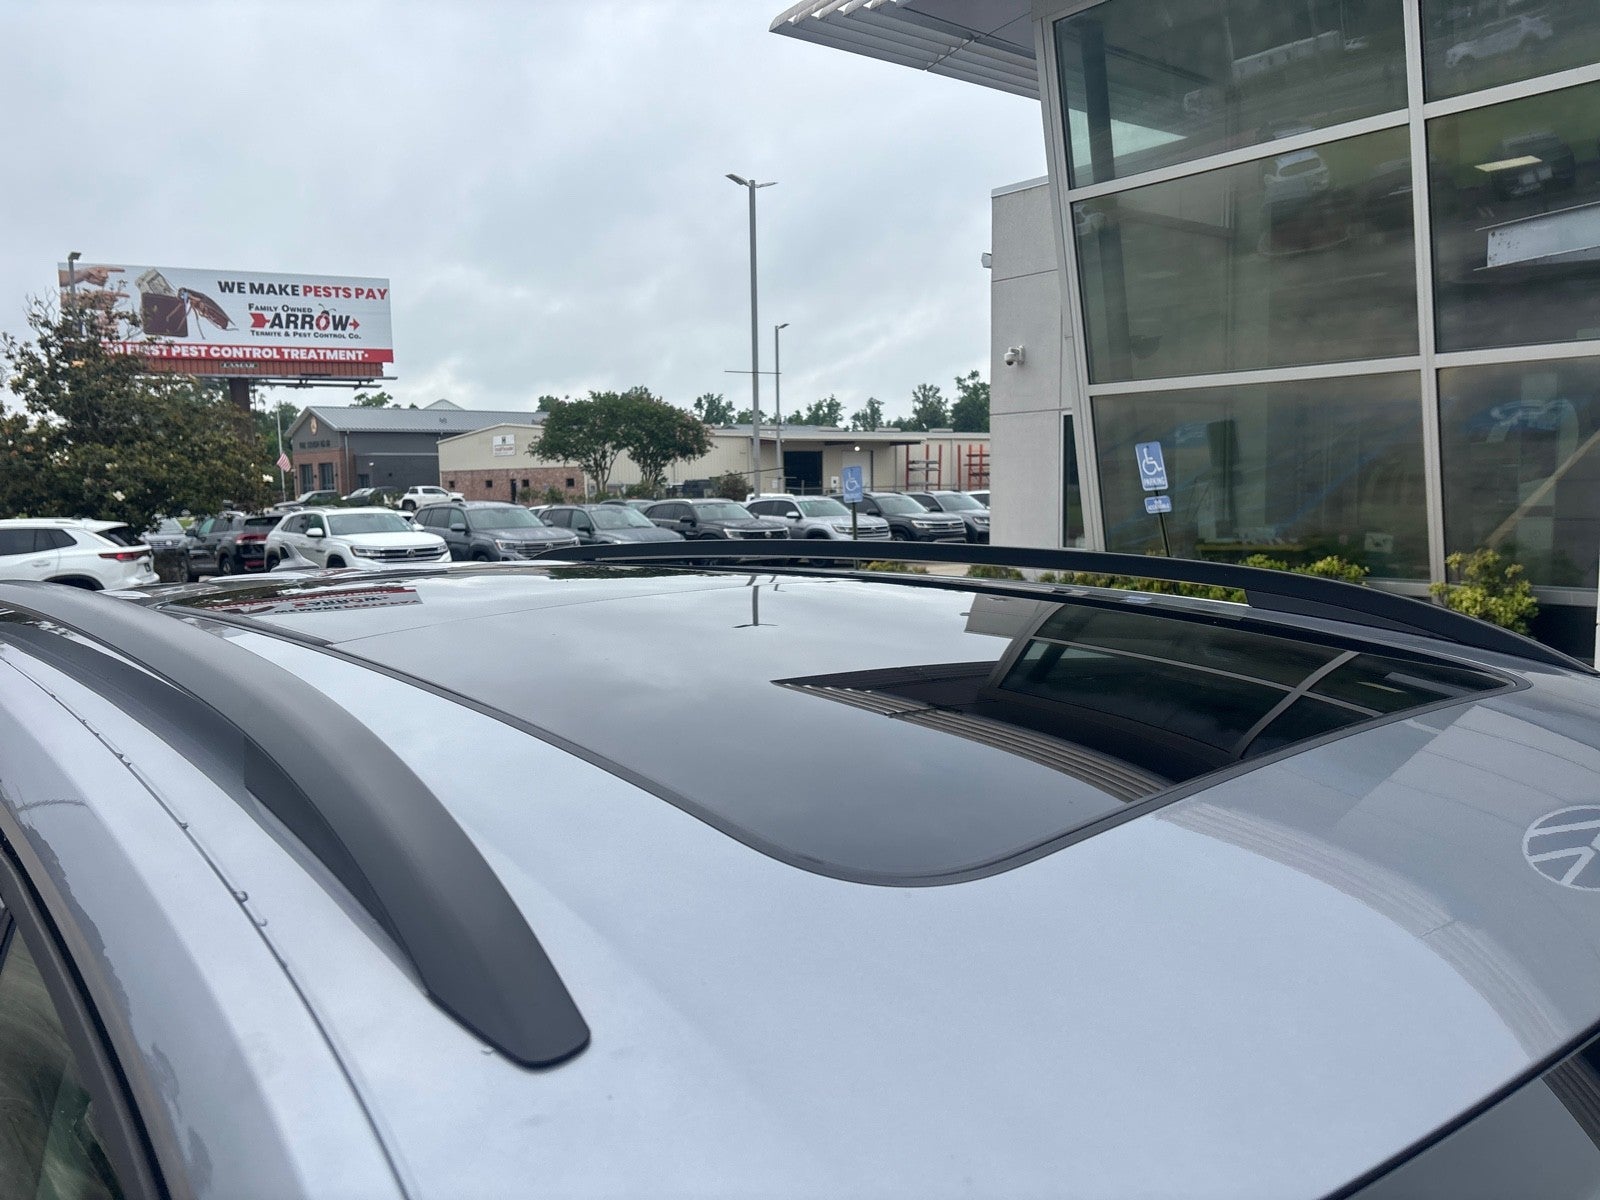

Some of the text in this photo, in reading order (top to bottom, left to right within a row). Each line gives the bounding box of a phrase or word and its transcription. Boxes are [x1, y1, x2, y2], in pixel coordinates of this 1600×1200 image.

[218, 281, 388, 301] WE MAKE PESTS PAY
[269, 313, 351, 331] ARROW
[283, 330, 291, 338] &
[292, 331, 312, 339] PEST
[313, 332, 347, 340] CONTROL
[170, 345, 207, 358] PEST
[209, 347, 280, 359] CONTROL
